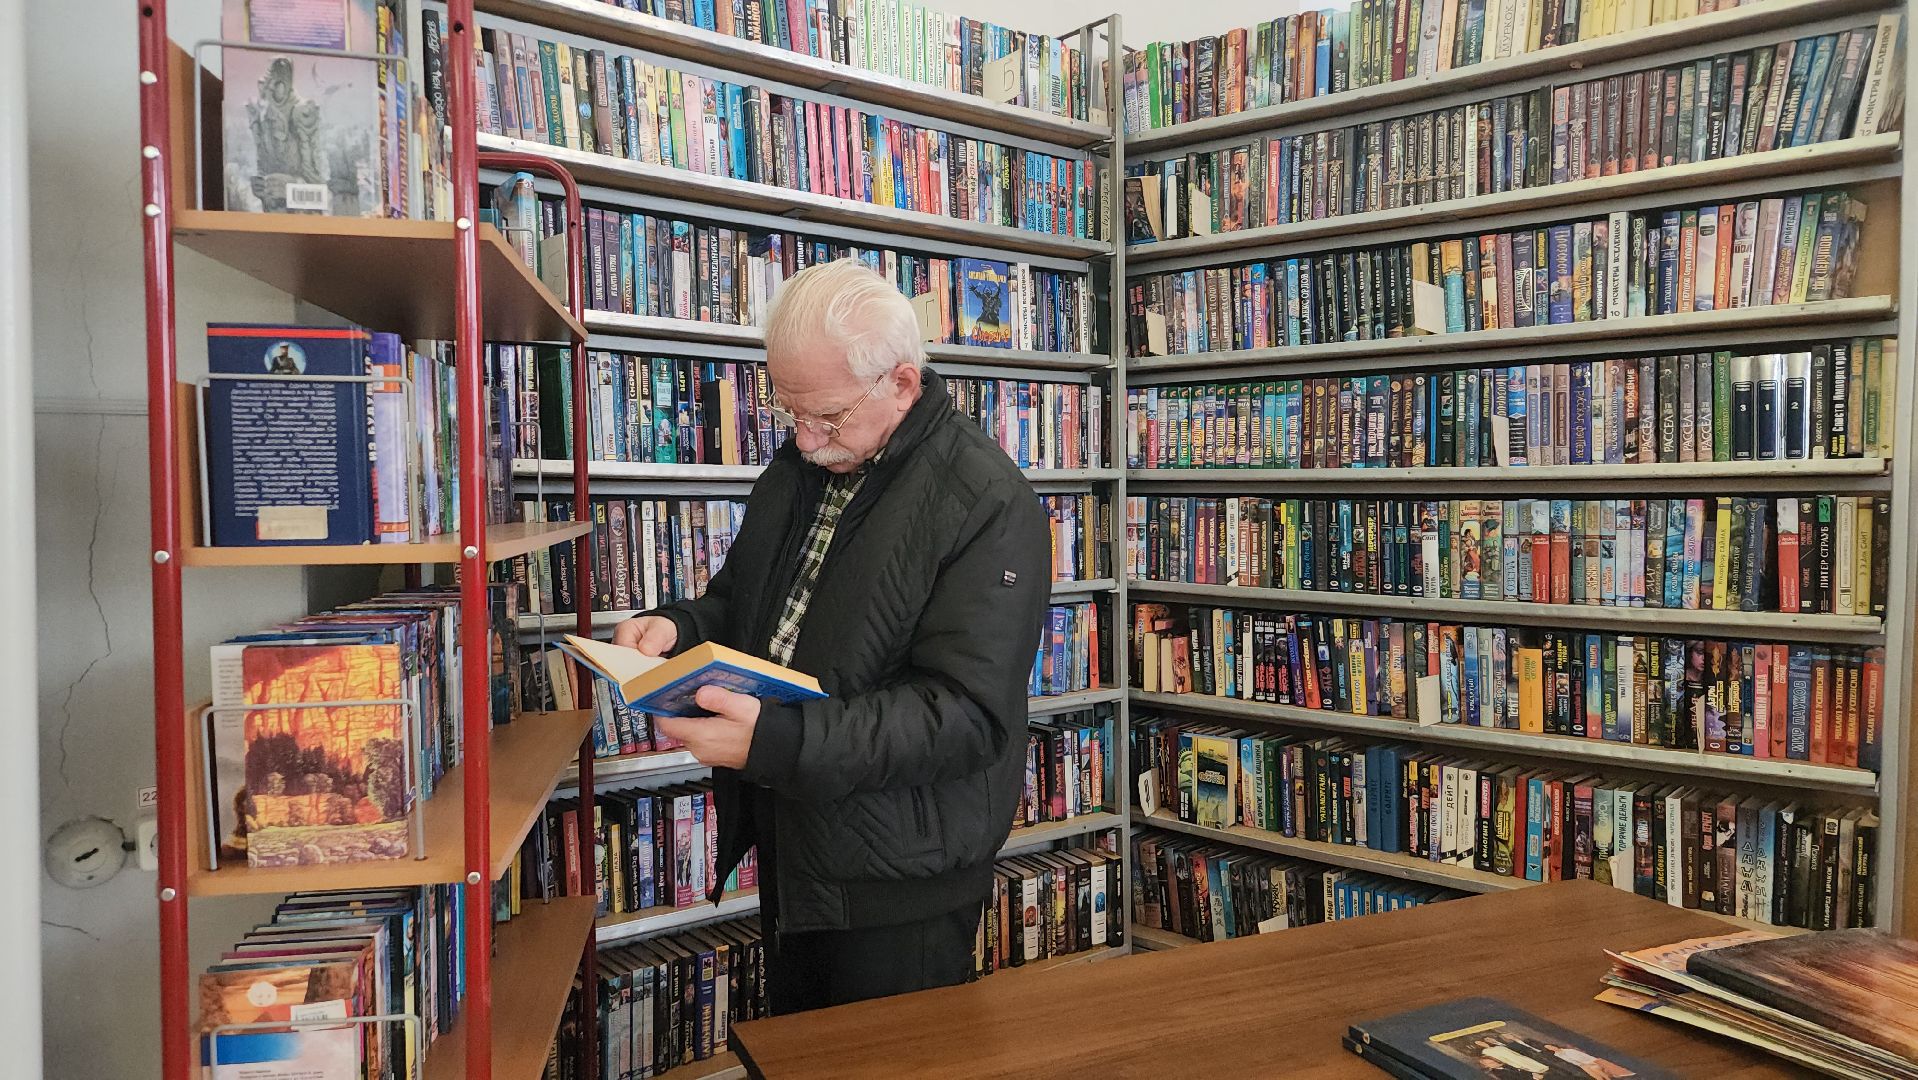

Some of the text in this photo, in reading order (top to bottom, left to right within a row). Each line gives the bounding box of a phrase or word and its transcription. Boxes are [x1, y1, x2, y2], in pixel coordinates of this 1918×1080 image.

[1502, 6, 1514, 52] МУРКОК
[1864, 24, 1892, 125] МОНСТРЫ ВСЕЛЕННОЙ
[711, 235, 720, 301] ПЕРЕСМЕШНИКИ
[1612, 219, 1621, 305] МОНСТРЫ ВСЕЛЕННОЙ
[1300, 273, 1309, 324] АЛЕКС ОРЛОВ
[1627, 368, 1635, 418] ВТОРЖЕНИЕ
[1792, 402, 1799, 410] 2
[1642, 416, 1653, 452] РАССЕЛ
[1664, 414, 1674, 452] РАССЕЛ
[1683, 415, 1693, 451] РАССЕЛ
[1701, 414, 1712, 451] РАССЕЛ
[1820, 526, 1829, 588] ПИТЕР СТРАУБ
[1815, 667, 1824, 709] УСПЕНСКИЙ
[1836, 667, 1844, 709] УСПЕНСКИЙ
[1849, 669, 1858, 711] УСПЕНСКИЙ
[1868, 670, 1877, 713] УСПЕНСКИЙ
[1792, 680, 1806, 752] МИР ПАУКОВ
[1444, 784, 1454, 809] ДЕЙР
[1618, 795, 1627, 852] ГОРЯЧИЕ ДЕНЬГИ
